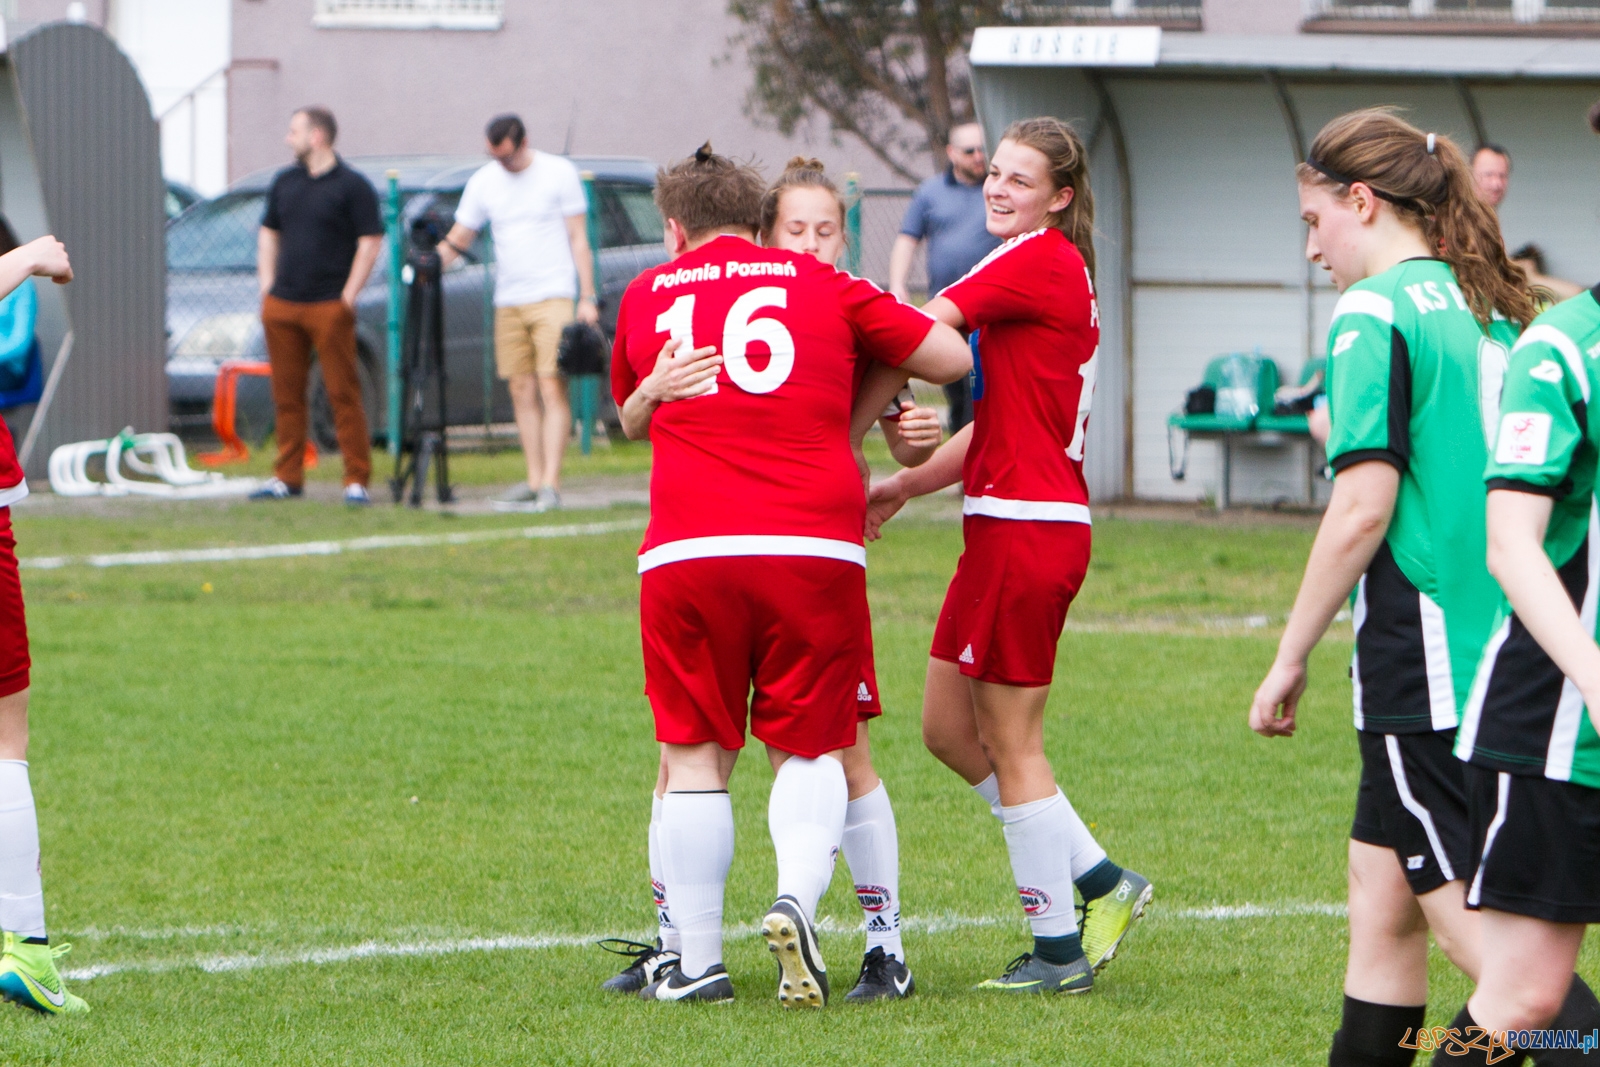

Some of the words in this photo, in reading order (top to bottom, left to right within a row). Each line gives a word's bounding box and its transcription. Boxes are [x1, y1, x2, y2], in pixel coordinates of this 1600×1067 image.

[652, 262, 721, 292] Polonia
[725, 260, 797, 279] Poznań
[1404, 281, 1448, 315] KS
[654, 286, 795, 396] 16
[1116, 879, 1133, 902] CR7
